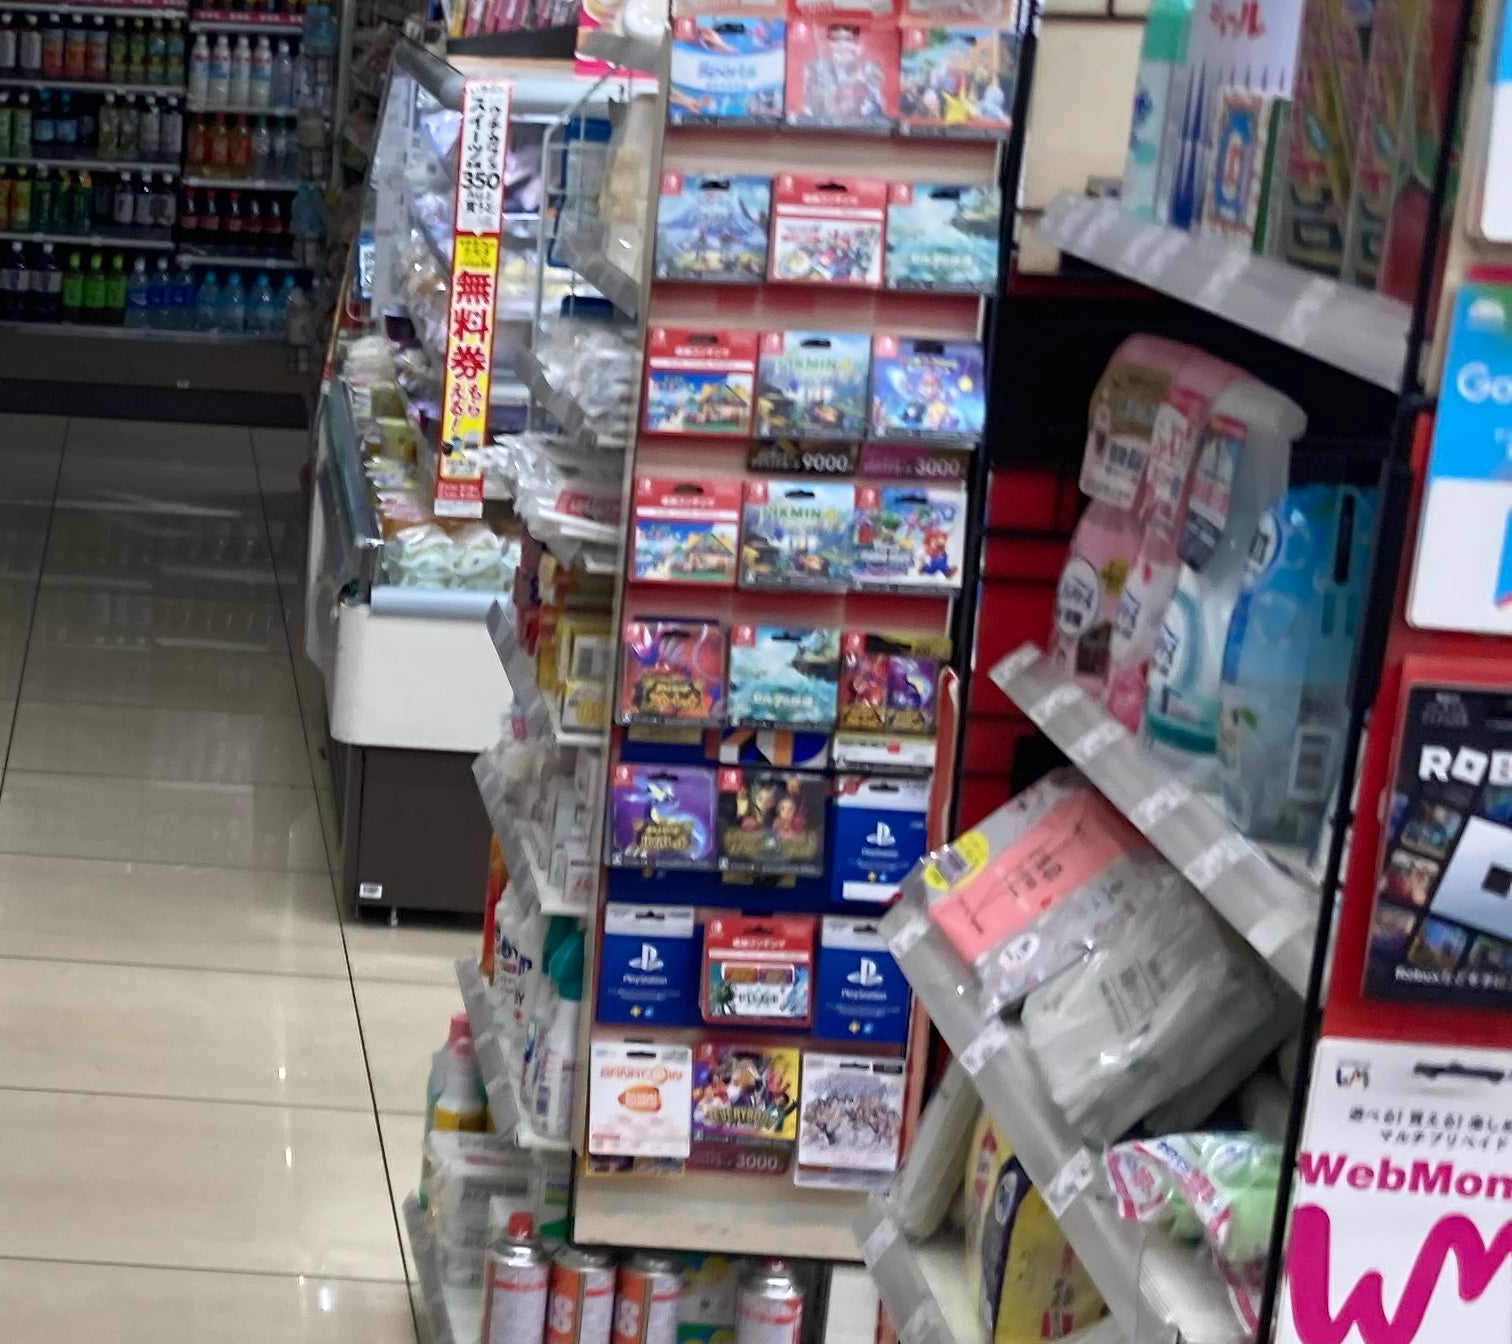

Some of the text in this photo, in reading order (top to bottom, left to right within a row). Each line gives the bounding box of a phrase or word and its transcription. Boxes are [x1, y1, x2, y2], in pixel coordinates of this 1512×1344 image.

[450, 270, 491, 380] 無料券
[801, 453, 849, 472] 9000
[915, 457, 961, 477] 3000
